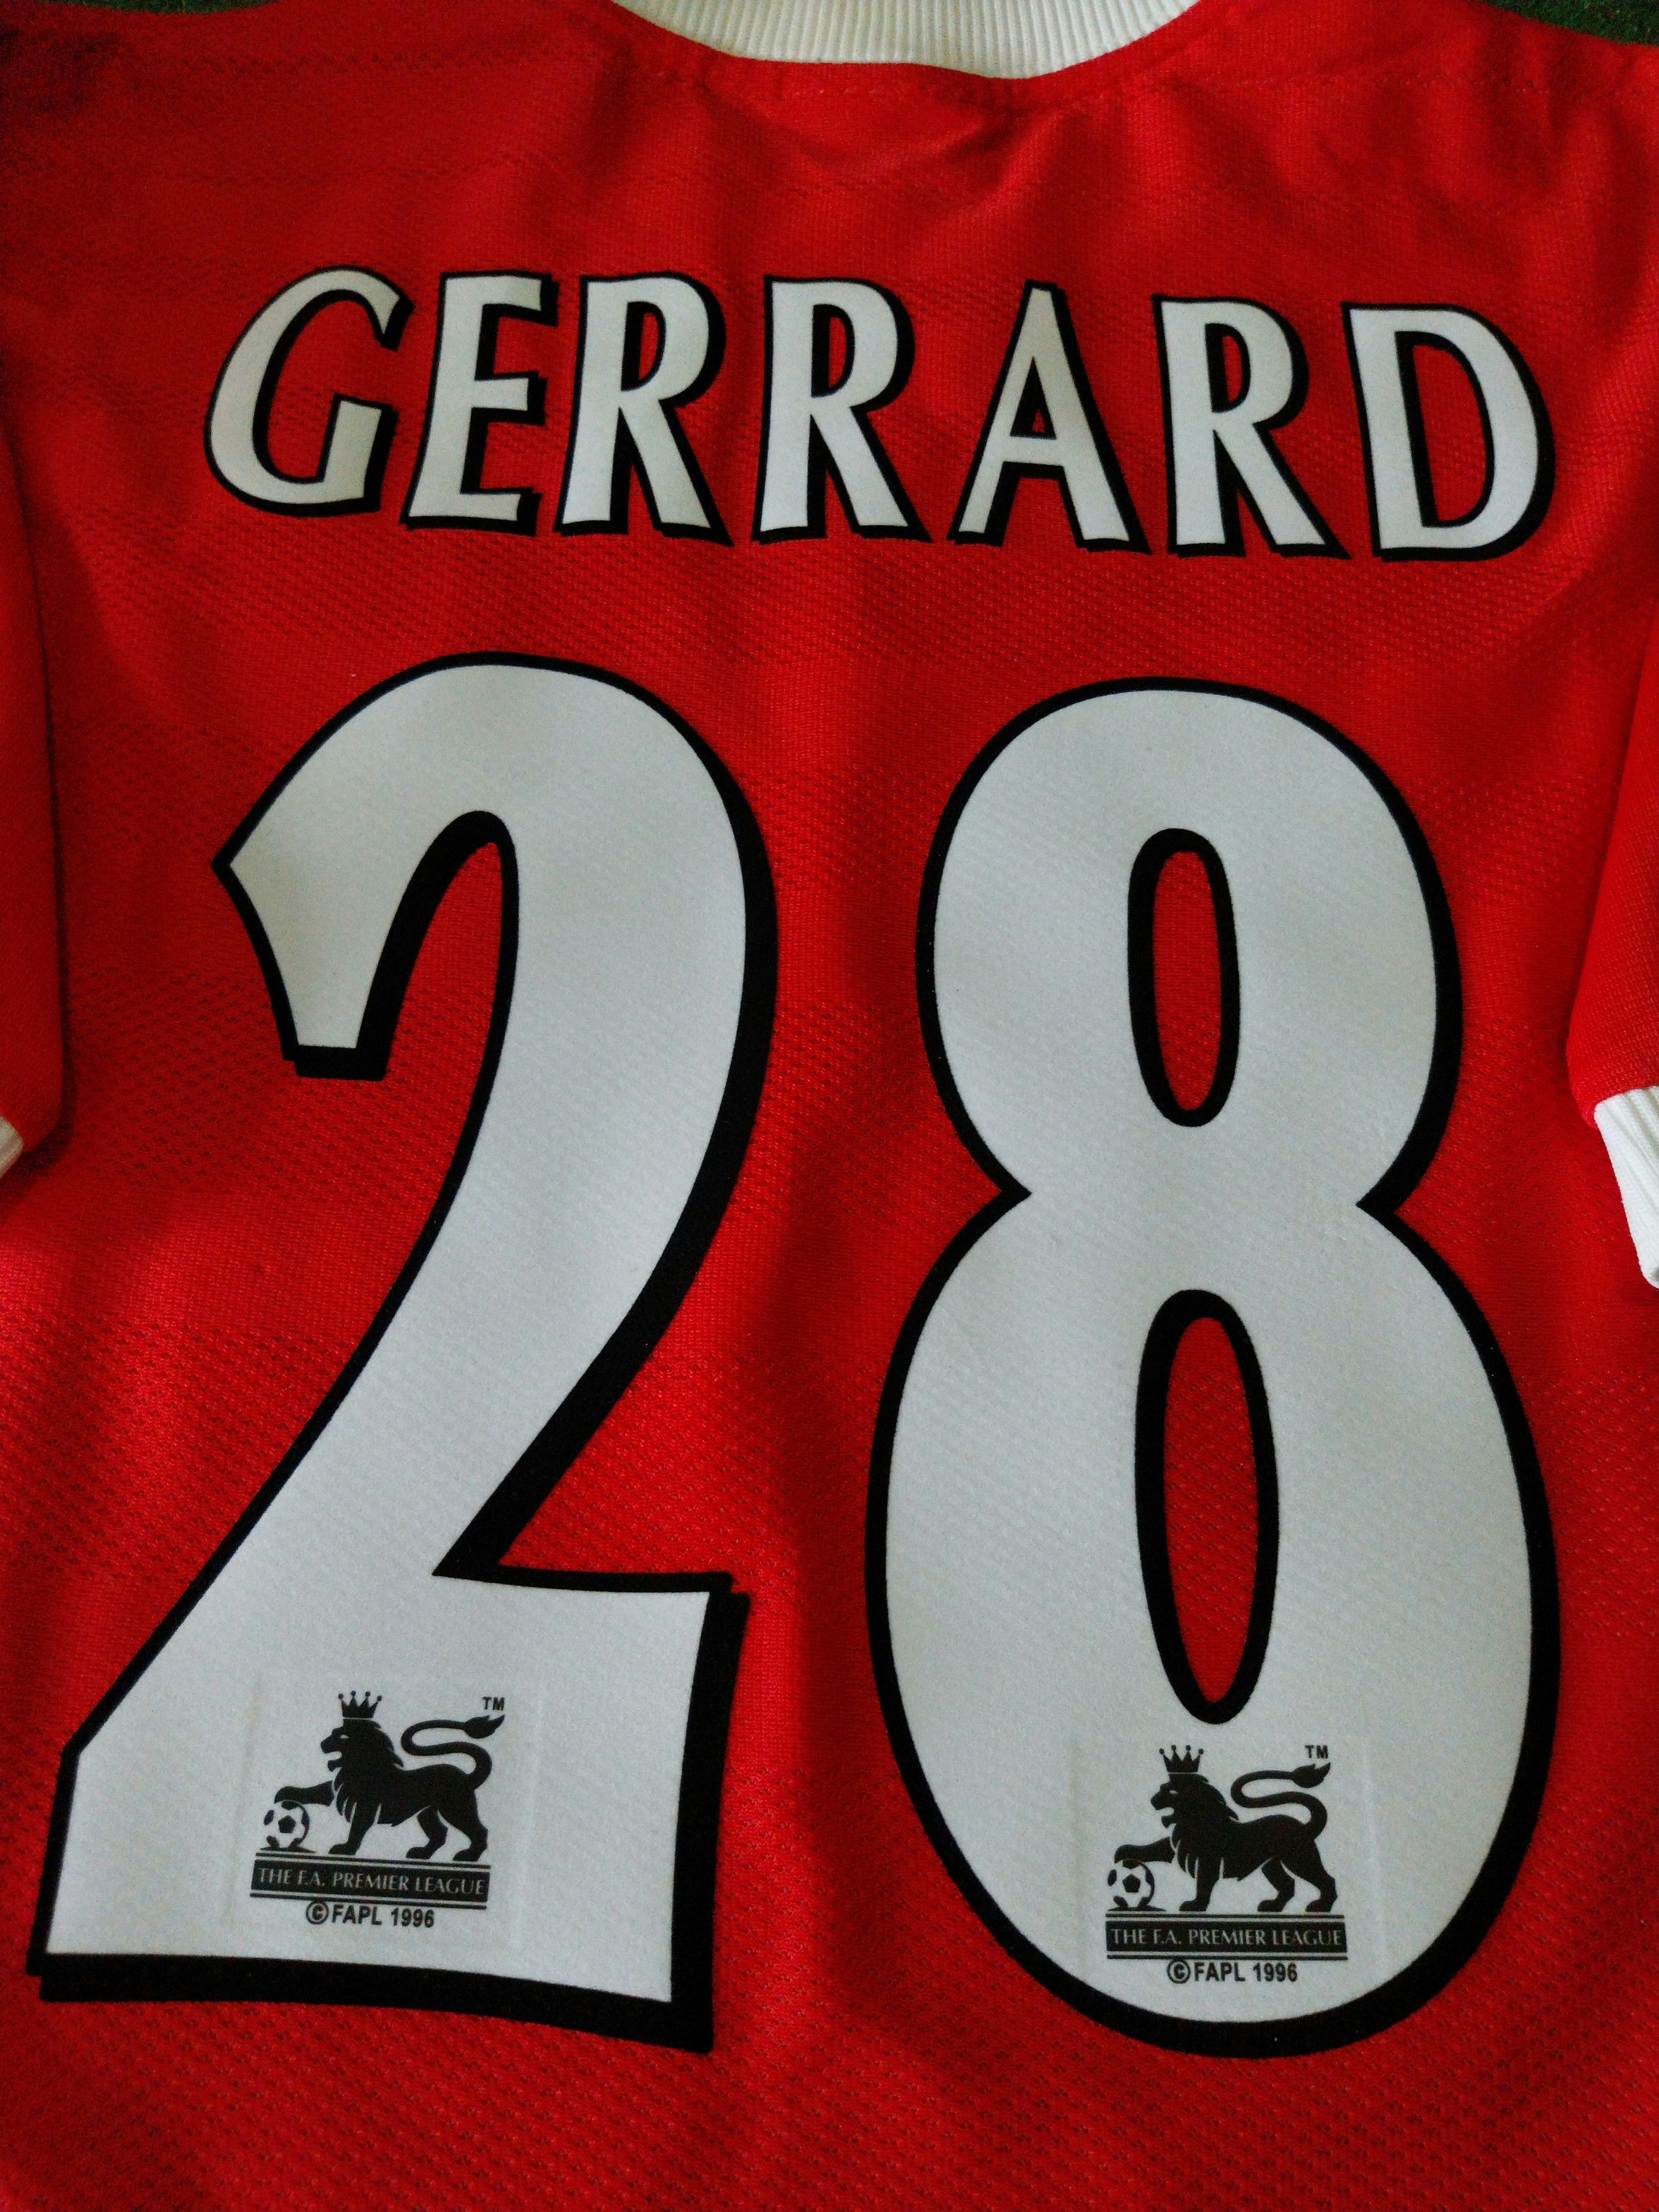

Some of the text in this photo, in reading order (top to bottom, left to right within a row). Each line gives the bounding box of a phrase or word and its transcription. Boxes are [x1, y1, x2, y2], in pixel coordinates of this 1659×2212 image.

[205, 265, 1556, 562] GERRARD
[28, 651, 1560, 2060] 28
[482, 1696, 505, 1711] TM
[1304, 1744, 1328, 1759] TM
[258, 1868, 486, 1895] THE F.A. PREMIER LEAGUE
[391, 1907, 435, 1928] 1996
[1111, 1928, 1343, 1946] THE F.A. PREMIER LEAGUE
[1252, 1961, 1298, 1983] 1996
